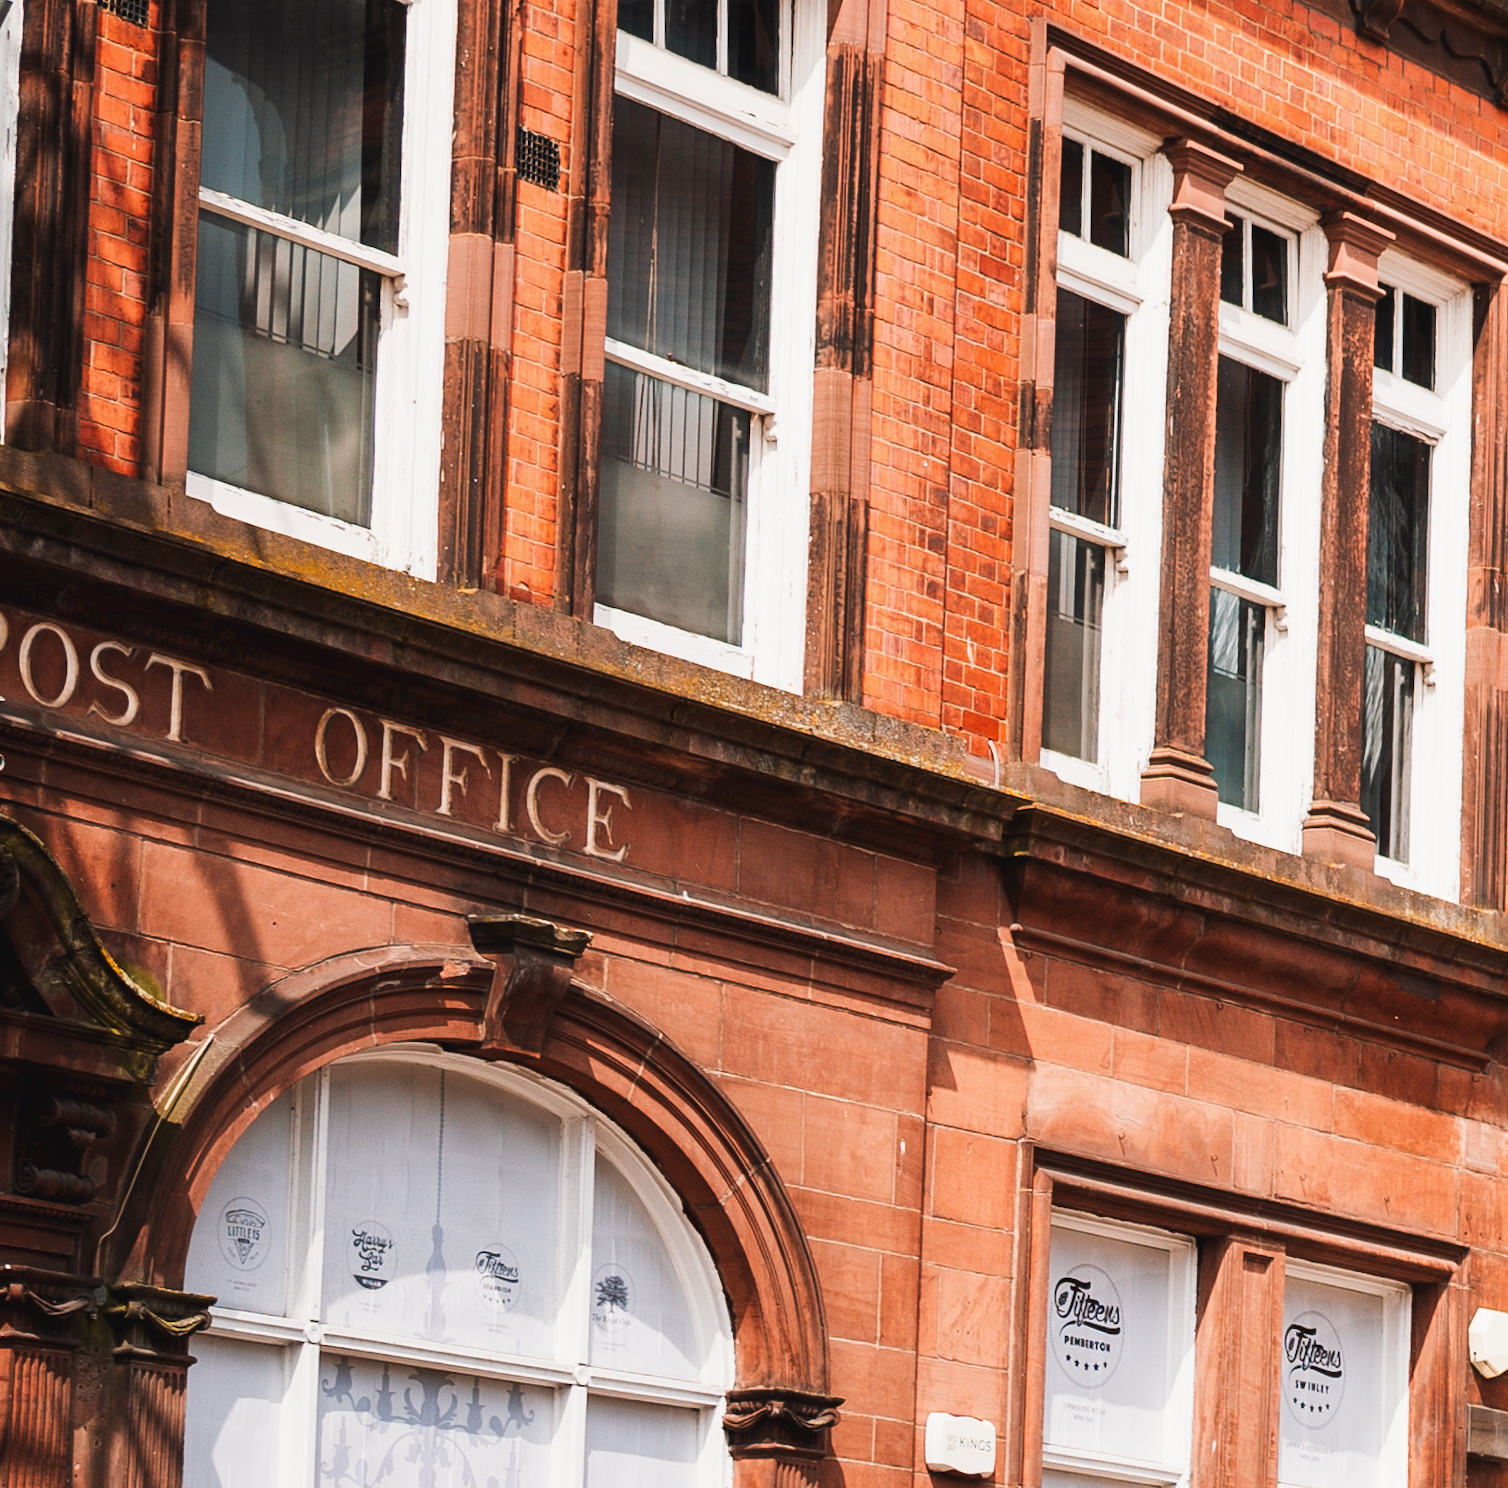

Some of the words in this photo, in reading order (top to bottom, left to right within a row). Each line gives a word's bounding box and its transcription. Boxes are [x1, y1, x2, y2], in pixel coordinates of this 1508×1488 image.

[0, 611, 212, 744] OST
[314, 706, 633, 862] OFFICE
[1054, 1277, 1121, 1332] Fifteens
[1064, 1335, 1111, 1353] PEMBERTON
[1284, 1323, 1342, 1375] Fifteens
[1295, 1379, 1330, 1395] SWINLEY
